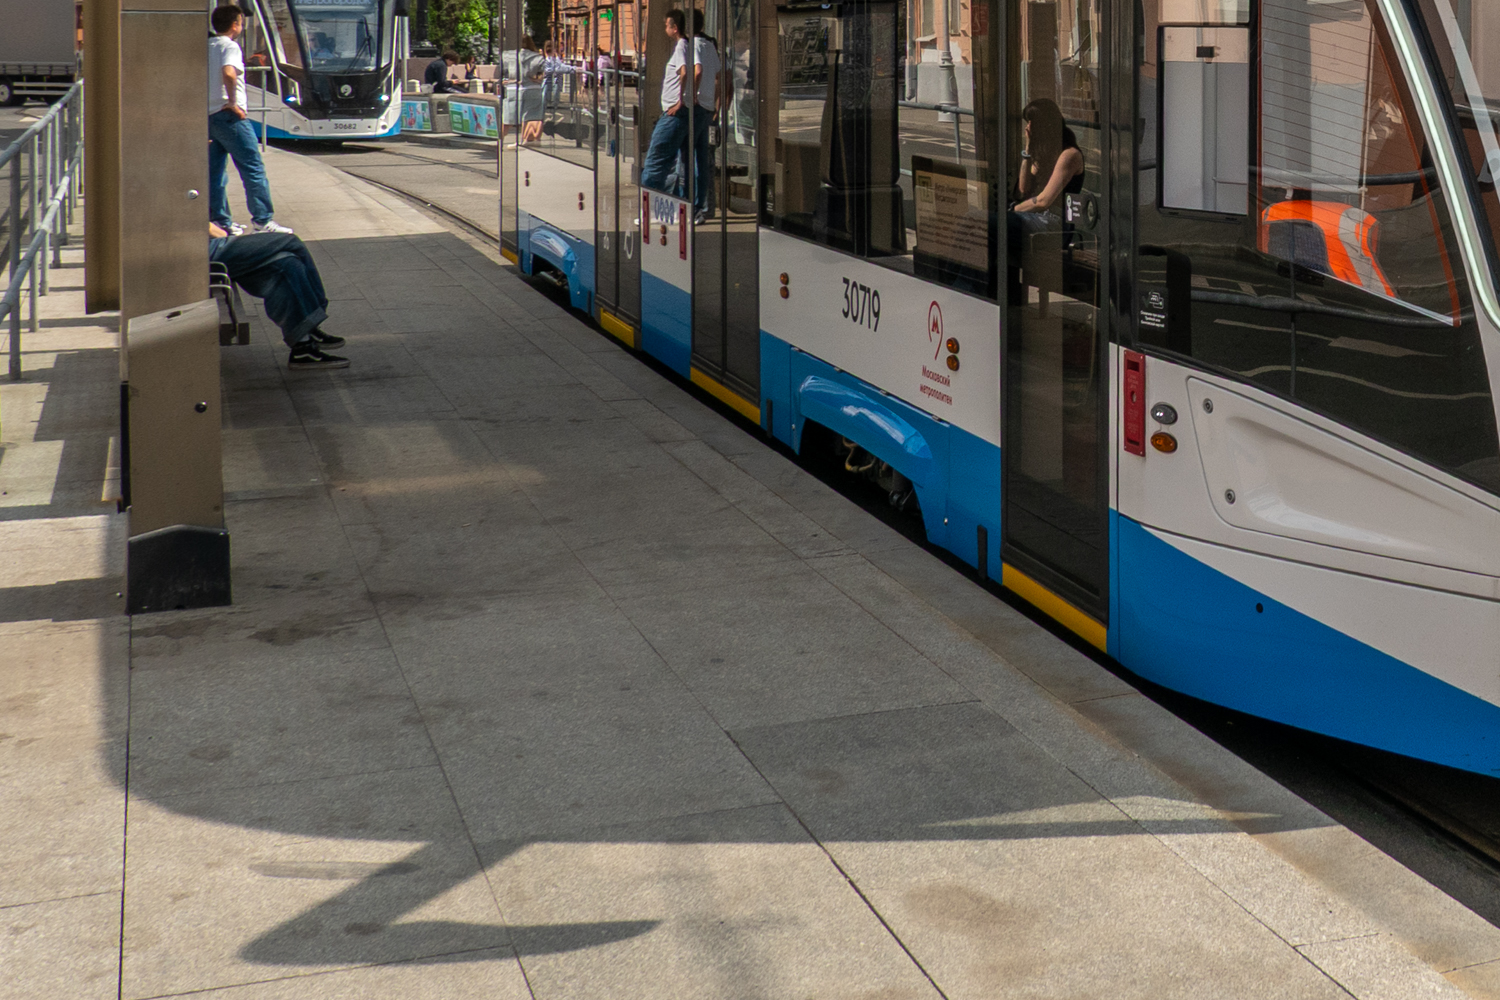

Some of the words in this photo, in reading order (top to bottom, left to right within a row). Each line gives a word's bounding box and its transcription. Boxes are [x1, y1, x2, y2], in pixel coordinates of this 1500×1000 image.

[842, 276, 881, 332] 30719
[922, 365, 951, 387] Московский
[920, 384, 953, 405] метрополитен
